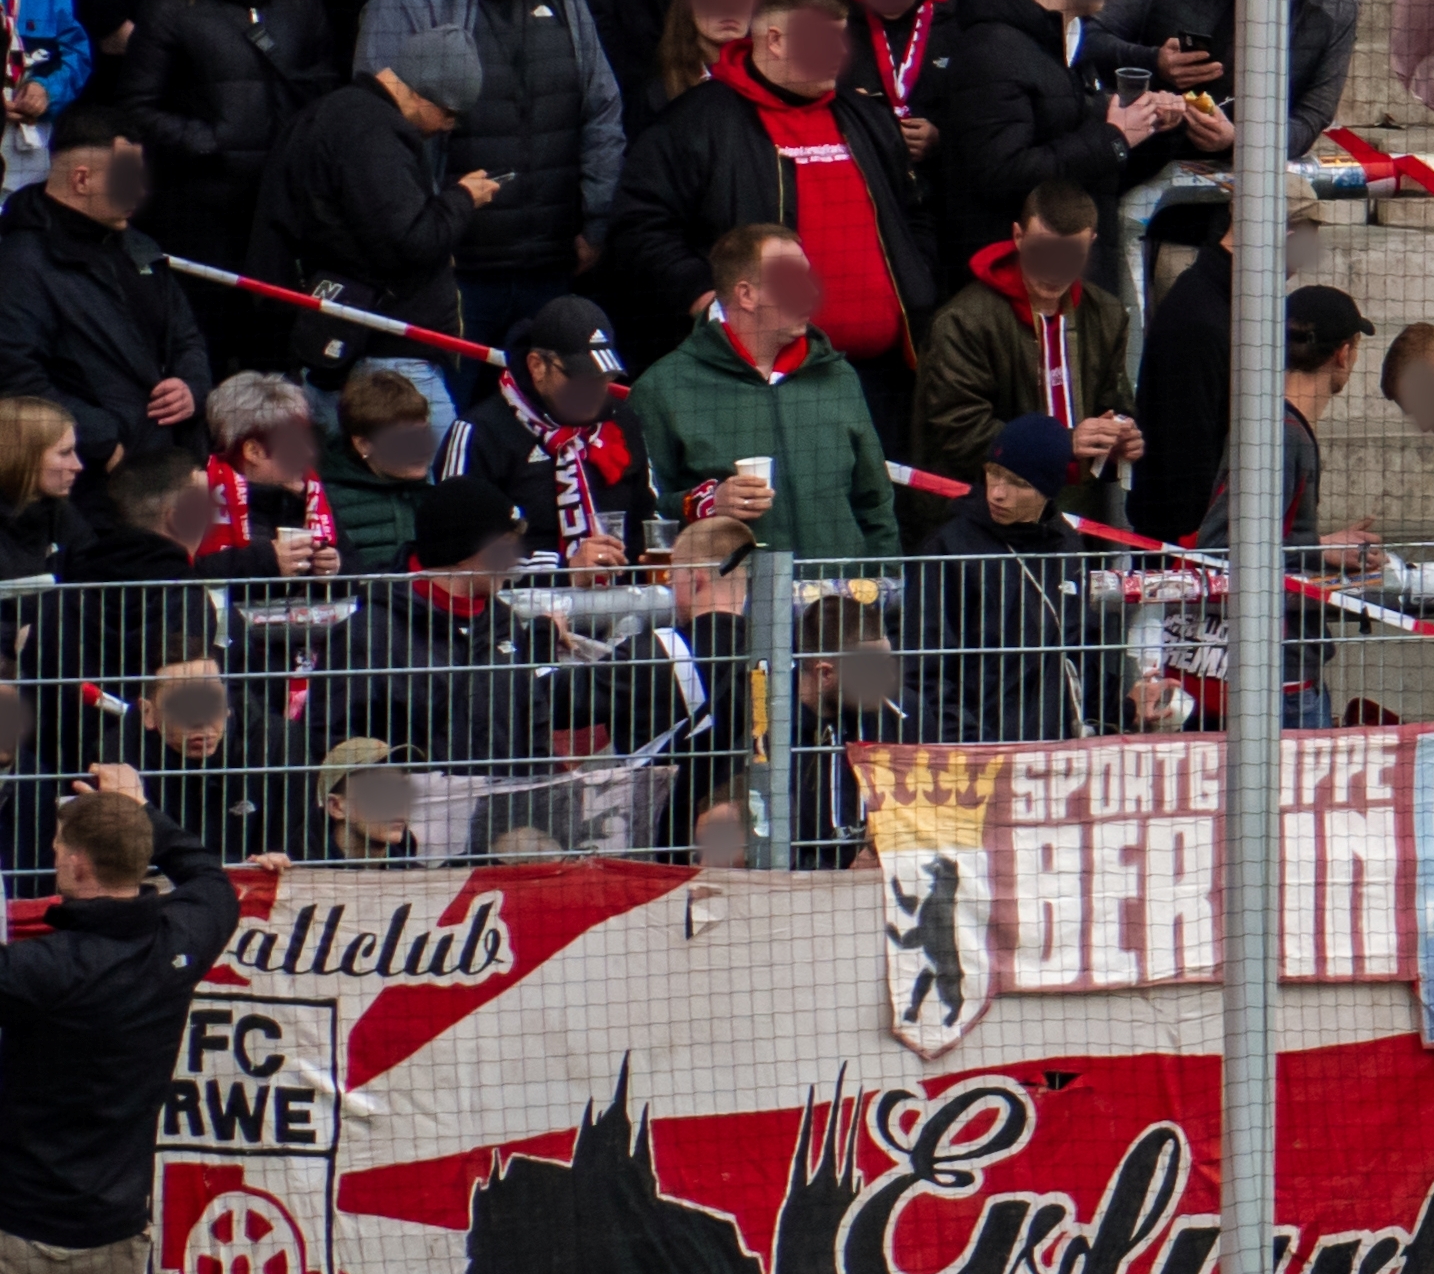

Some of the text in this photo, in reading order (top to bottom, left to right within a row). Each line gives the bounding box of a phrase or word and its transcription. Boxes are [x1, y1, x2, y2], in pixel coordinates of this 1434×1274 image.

[1012, 805, 1400, 989] BERIN
[230, 901, 505, 979] allclub
[188, 1008, 286, 1078] FC
[163, 1085, 318, 1145] RWE
